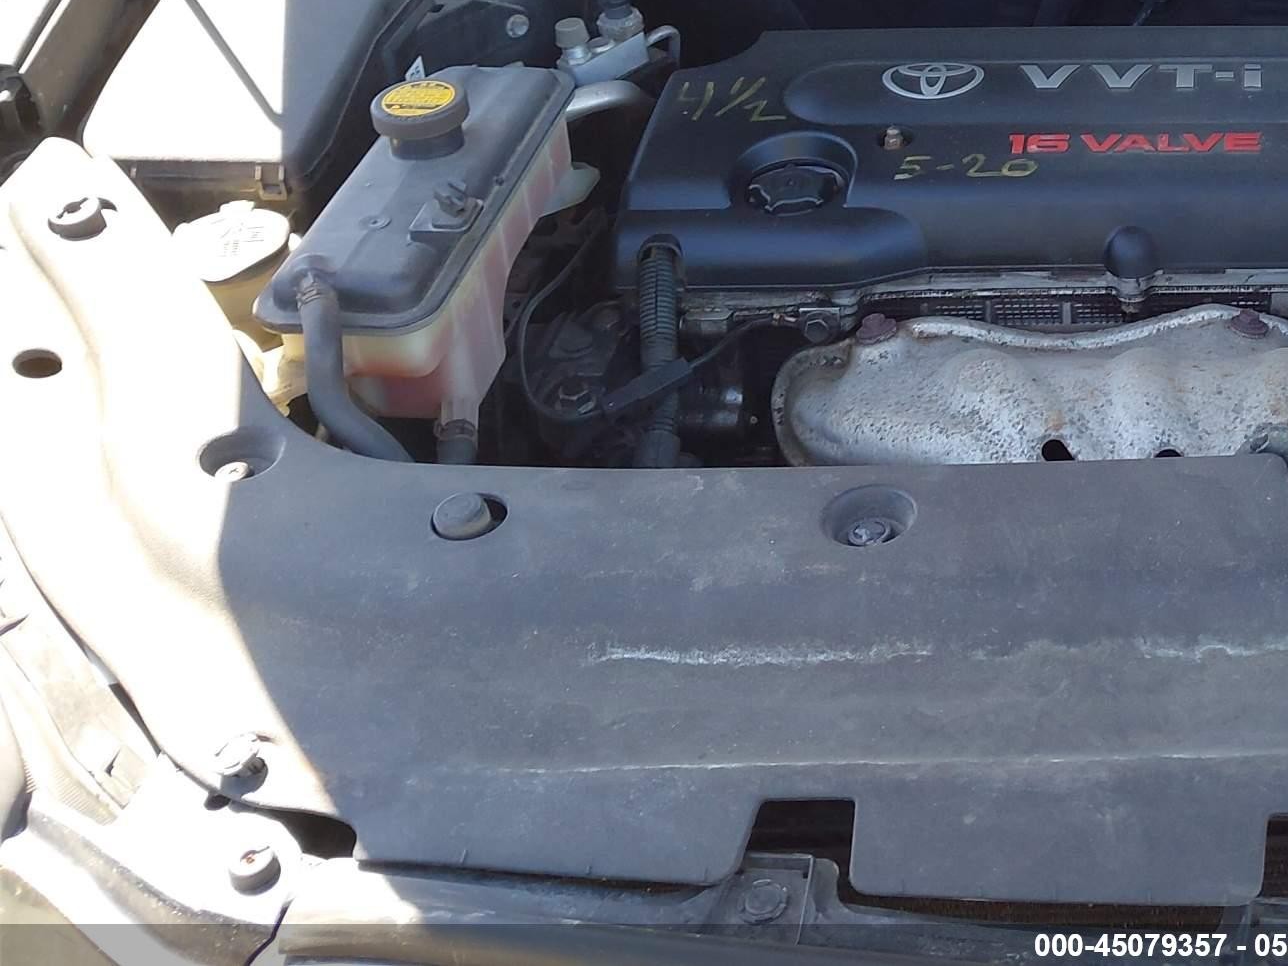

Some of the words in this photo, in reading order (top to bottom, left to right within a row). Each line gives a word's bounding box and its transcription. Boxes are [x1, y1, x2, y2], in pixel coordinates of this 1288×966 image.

[1019, 64, 1262, 89] VVT-i
[1009, 133, 1070, 154] 16
[1080, 133, 1263, 154] VALVE
